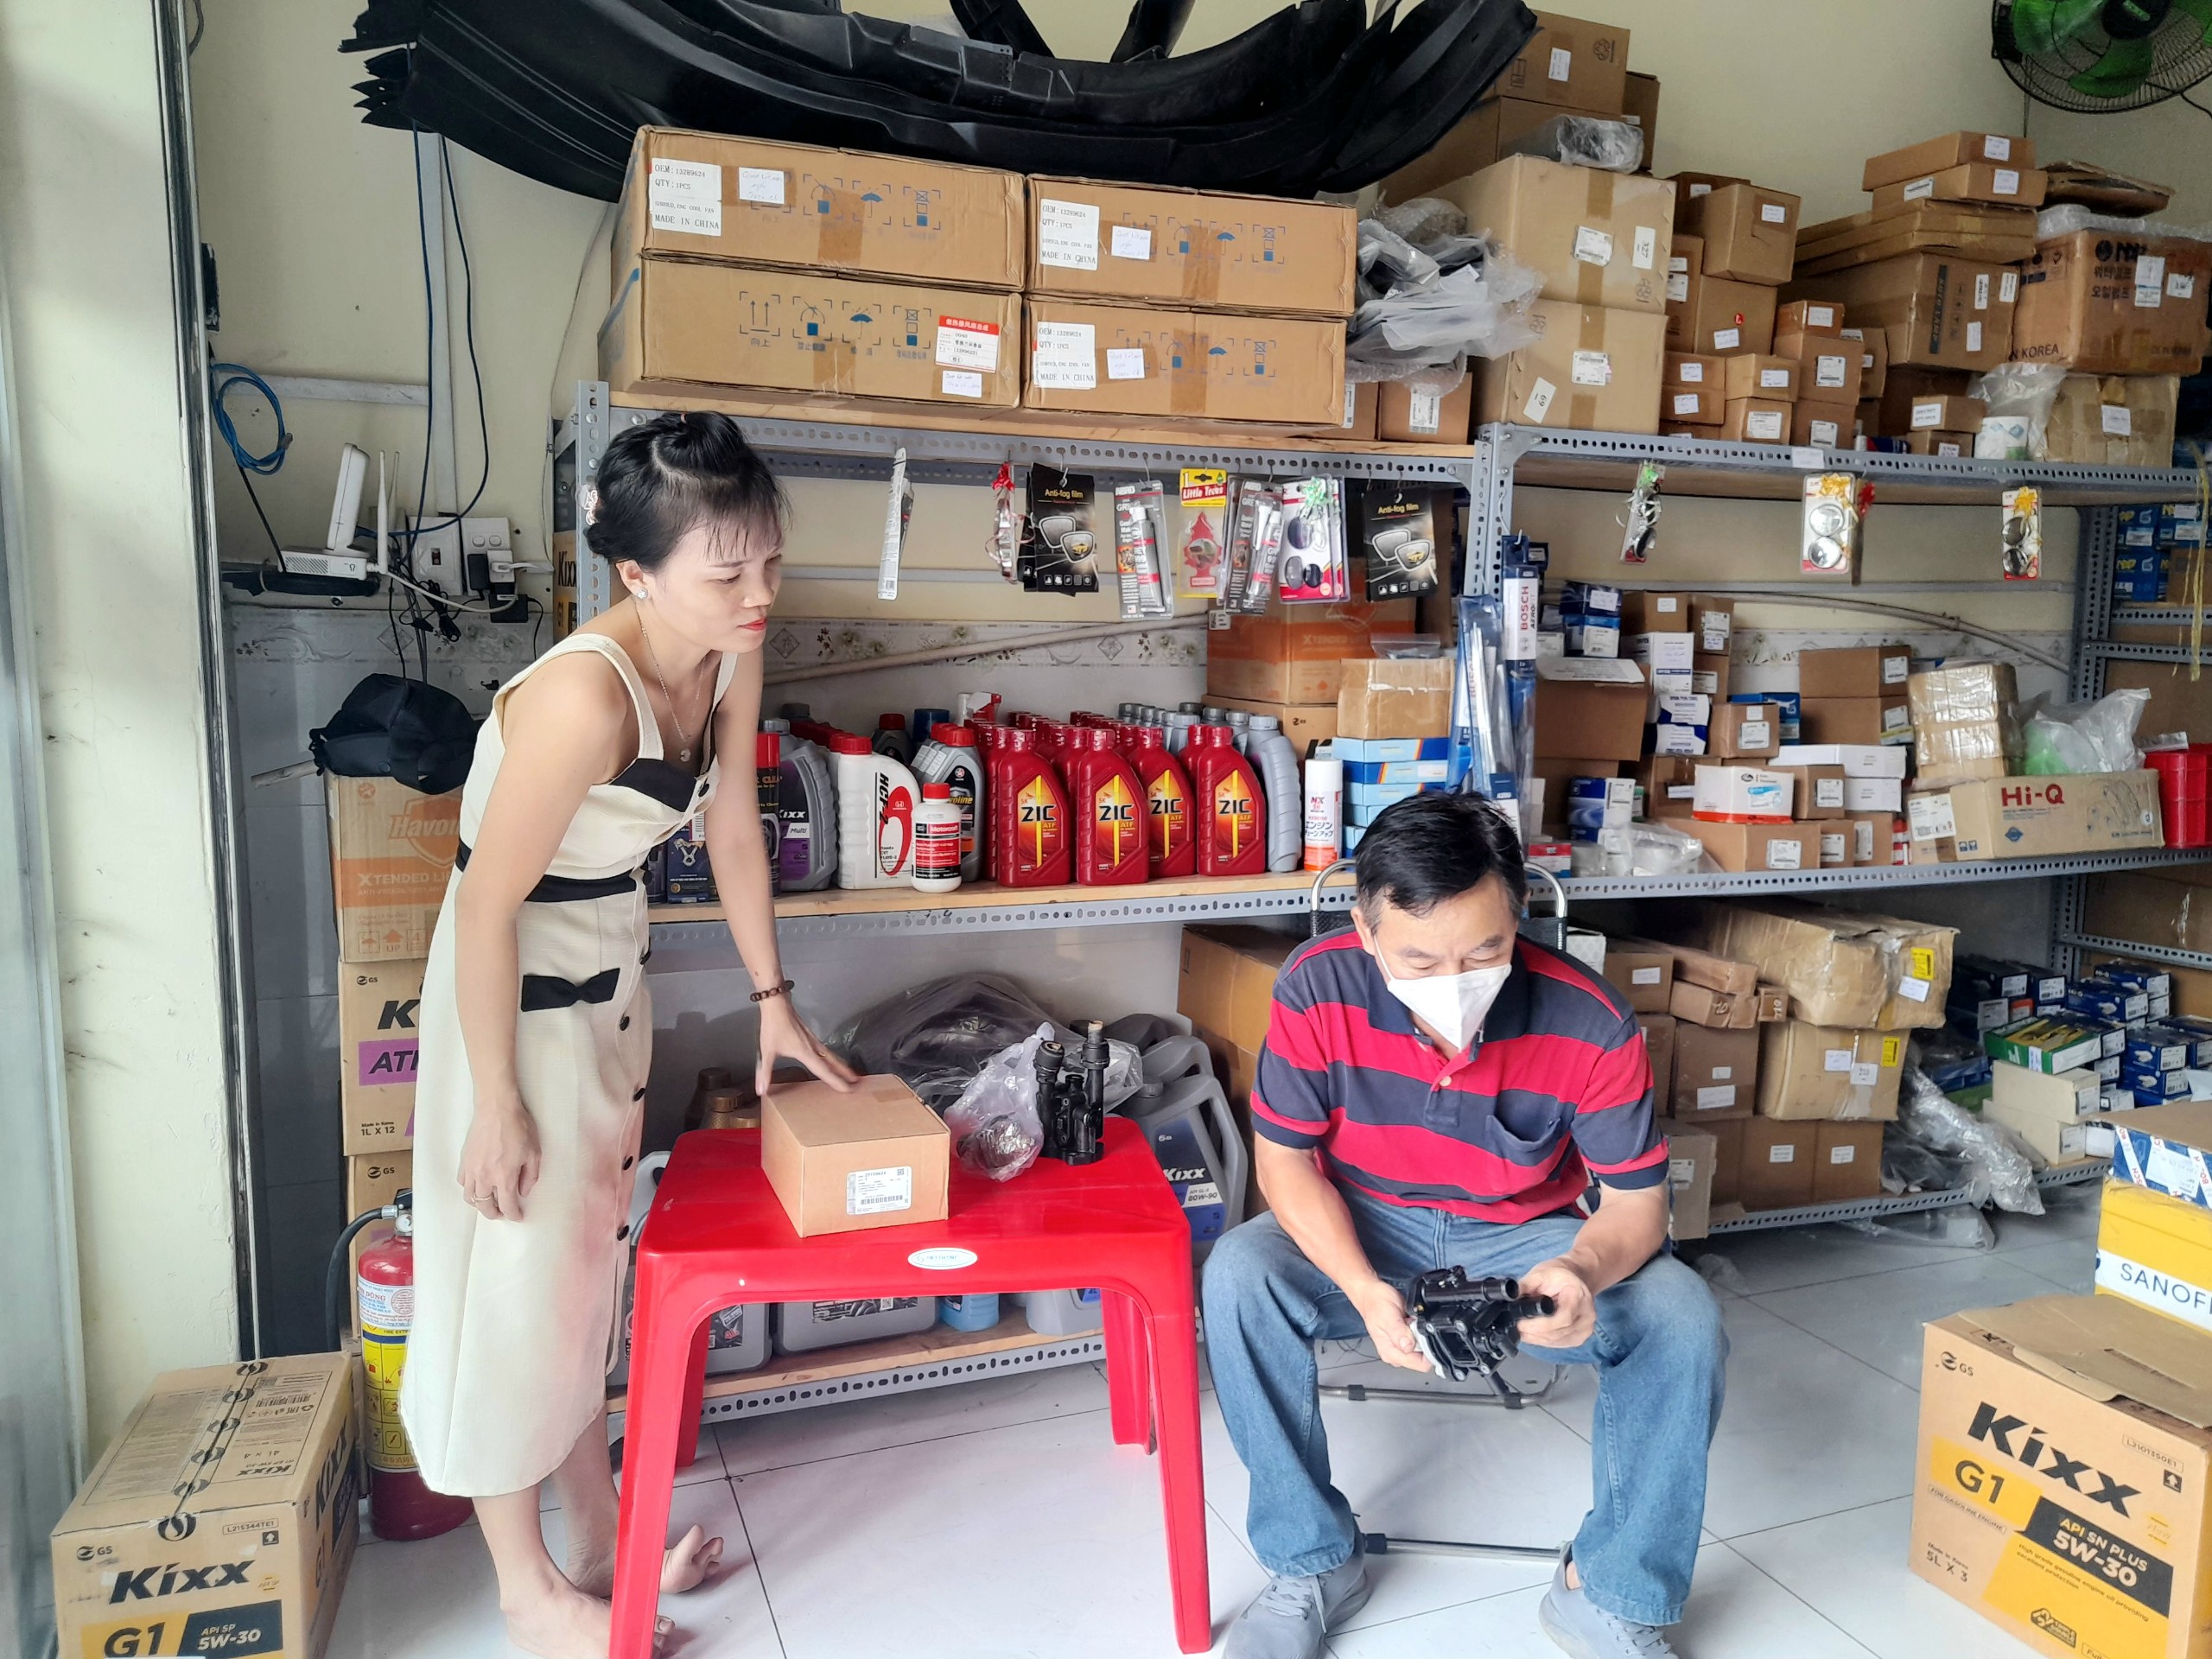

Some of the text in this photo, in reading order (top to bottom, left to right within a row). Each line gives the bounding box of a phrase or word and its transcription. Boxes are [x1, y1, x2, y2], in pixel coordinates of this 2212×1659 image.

[655, 164, 674, 175] OEM:
[655, 178, 674, 188] QTY:
[1042, 205, 1059, 214] OEM:
[655, 215, 675, 224] MADE
[695, 219, 720, 229] CHINA
[1042, 219, 1058, 227] QTY:
[1042, 251, 1058, 259] MADE
[1075, 254, 1096, 264] CHINA
[1039, 327, 1055, 336] OEM:
[1039, 340, 1055, 349] QTY:
[2021, 344, 2059, 359] KOREA
[1045, 488, 1084, 499] Anti-fog film
[1183, 486, 1224, 499] Little Trees
[1377, 502, 1420, 515] Anti-fog film
[1521, 586, 1529, 631] BOSCH
[879, 772, 889, 824] HCF-2
[2001, 784, 2064, 808] Hi-Q
[1020, 804, 1058, 822] ZIC
[1098, 804, 1135, 821] ZIC
[1150, 798, 1183, 815] ZIC
[1218, 798, 1252, 815] ZIC
[930, 824, 958, 833] Motorcraft
[358, 872, 429, 887] XTENDED
[377, 999, 421, 1030] K
[1163, 1168, 1205, 1181] Kixx
[1188, 1192, 1217, 1202] 80W-90
[1959, 1363, 1974, 1377] GS
[1967, 1402, 2142, 1518] Kixx
[1955, 1459, 2005, 1504] G1
[97, 1546, 112, 1555] GS
[2060, 1518, 2149, 1573] API SN PLUS
[2053, 1530, 2138, 1587] 5W-30
[1926, 1550, 1942, 1567] 5L
[1961, 1570, 1968, 1583] 3
[109, 1560, 255, 1605] Kixx
[201, 1624, 236, 1637] API SP
[104, 1622, 166, 1657] G1
[197, 1629, 261, 1650] 5W-30
